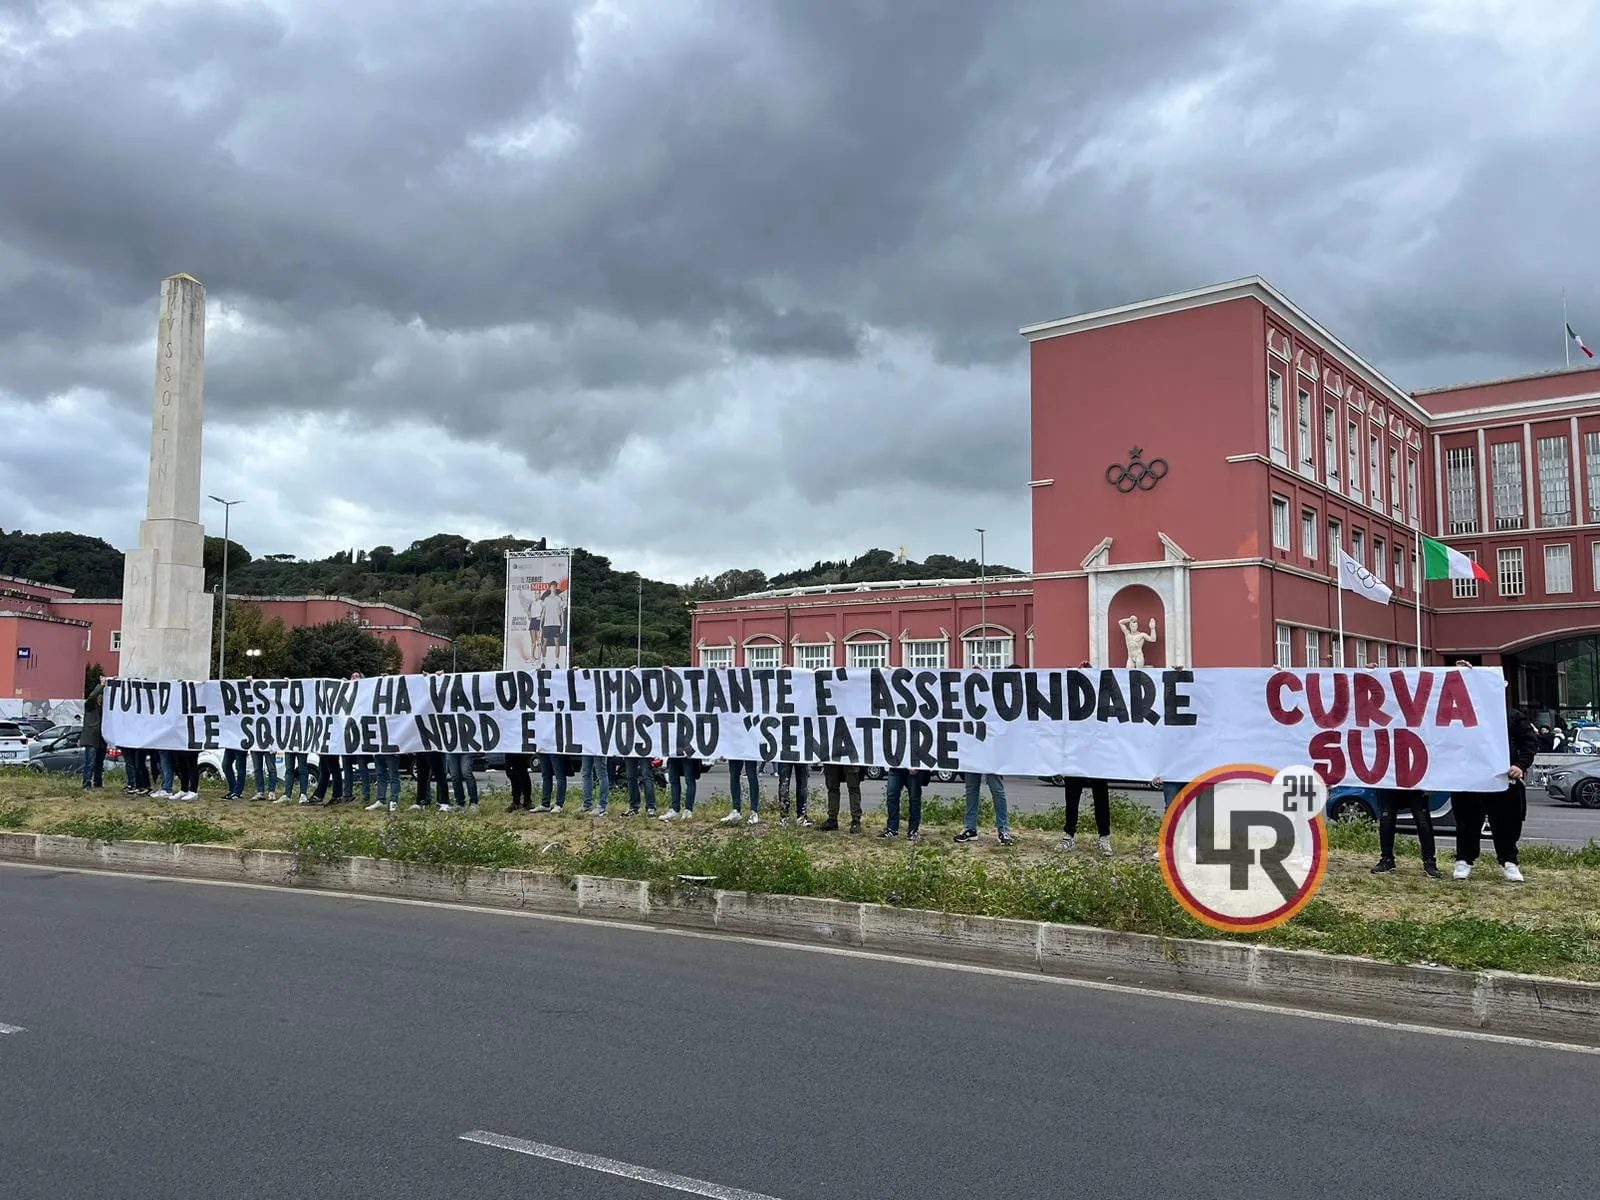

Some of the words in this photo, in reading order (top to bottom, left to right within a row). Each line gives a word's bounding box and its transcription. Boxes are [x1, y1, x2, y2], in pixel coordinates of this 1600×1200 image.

[107, 680, 171, 714] TUTTO
[181, 681, 207, 714] IL
[220, 680, 302, 716] RESTO
[315, 679, 358, 716] NON
[372, 676, 412, 715] HA
[870, 668, 1198, 726] ASSECONDARE
[1266, 670, 1479, 728] CURVA
[187, 715, 219, 750] LE
[240, 715, 335, 751] SQUADRE
[344, 716, 400, 753] DEL
[415, 713, 500, 752] NORD
[522, 712, 537, 753] E
[556, 712, 583, 753] IL
[596, 713, 720, 757] VOSTRO
[743, 714, 987, 770] "SENATORE"
[1308, 728, 1429, 788] SUD
